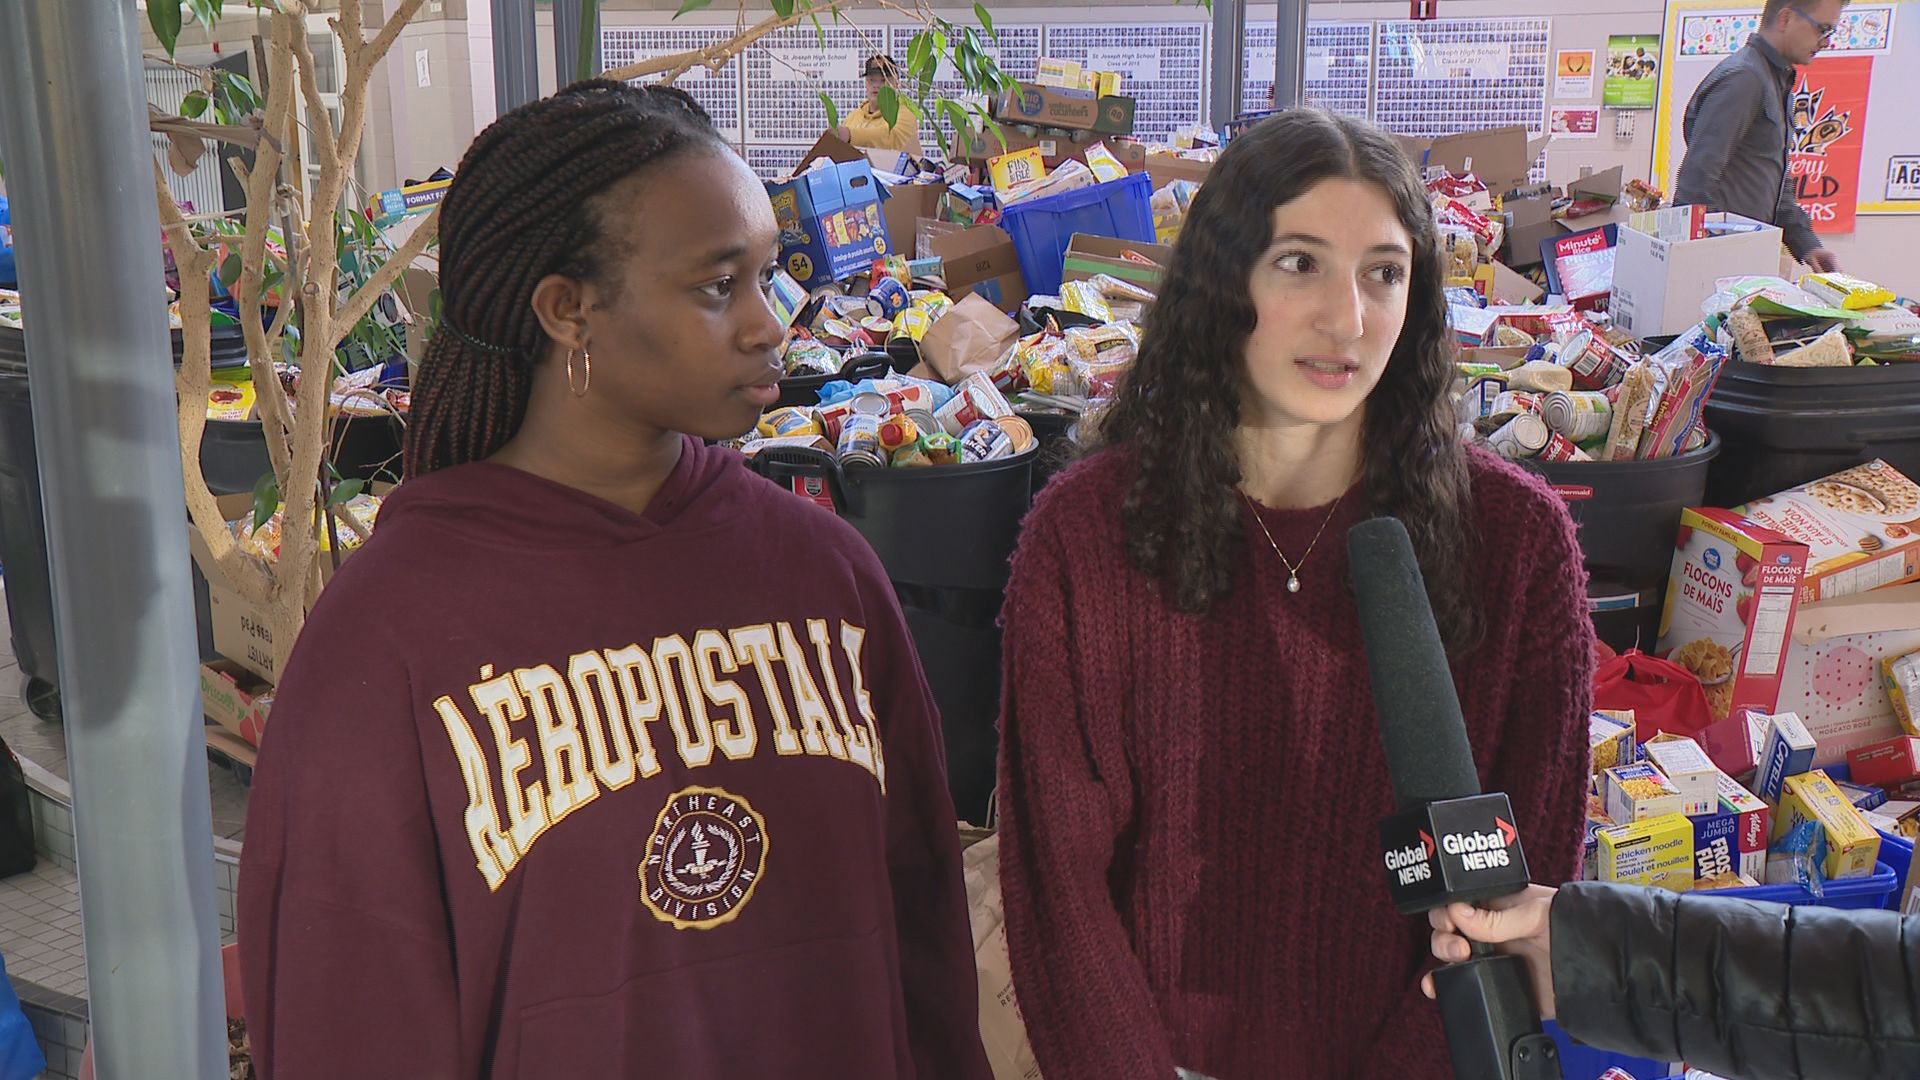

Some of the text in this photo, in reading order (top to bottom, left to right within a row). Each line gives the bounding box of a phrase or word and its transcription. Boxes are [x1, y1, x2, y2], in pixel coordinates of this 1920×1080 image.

[791, 54, 811, 62] Joseph
[813, 54, 826, 62] High
[1101, 53, 1121, 61] Joseph
[1122, 53, 1136, 61] High
[1435, 49, 1458, 57] Joseph
[1460, 49, 1475, 57] High
[406, 192, 435, 205] FORMAT
[1559, 235, 1600, 252] Minute
[792, 257, 808, 272] 54
[1783, 508, 1807, 529] NOIX
[1683, 561, 1733, 598] FLOCONS
[1762, 565, 1802, 575] FLOCONS
[1775, 574, 1797, 583] MAÏS
[1683, 583, 1724, 614] DE MAÏS
[1818, 719, 1872, 735] MOSCATO ROSÉ
[1767, 740, 1789, 798] CATELLI
[1701, 825, 1735, 840] JUMBO
[1707, 817, 1735, 830] MEGA
[1747, 812, 1761, 848] Kellogg's
[1443, 828, 1506, 855] Global
[1616, 847, 1652, 860] chicken
[1653, 839, 1683, 853] noodle
[1385, 841, 1428, 871] Global
[1462, 849, 1510, 871] NEWS
[1398, 862, 1432, 886] NEWS
[1616, 866, 1645, 879] poulet
[1646, 863, 1655, 871] et
[1656, 855, 1689, 869] nouilles
[649, 868, 756, 919] DIVISION
